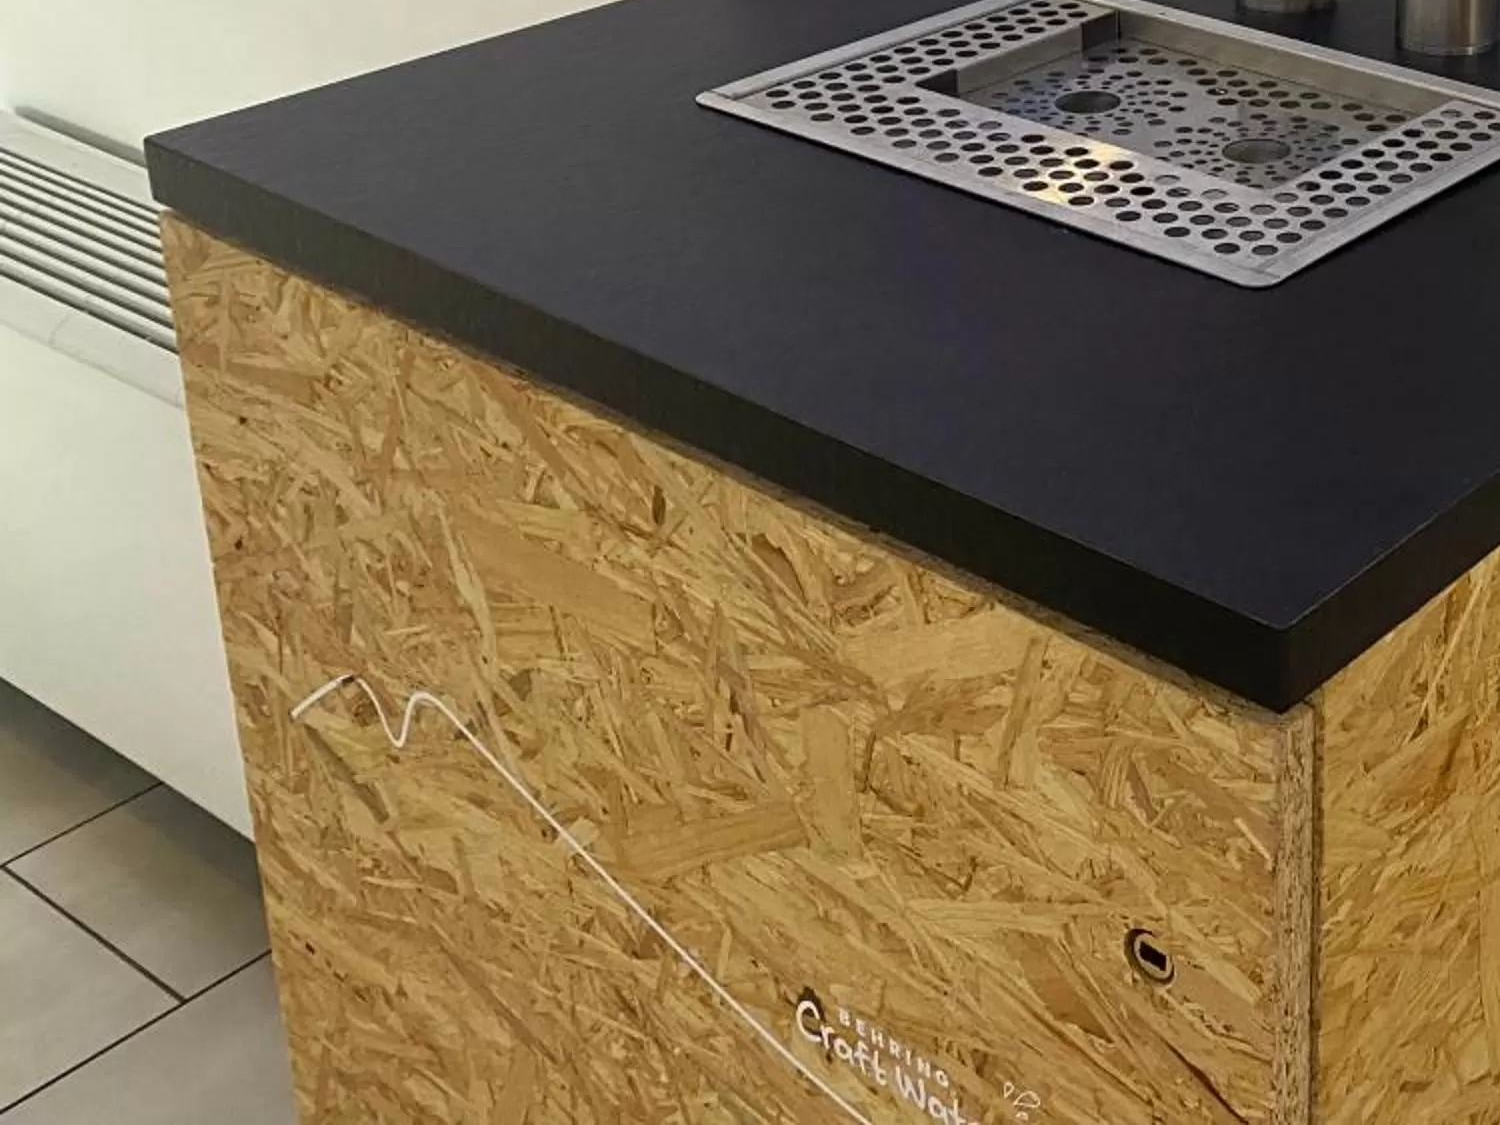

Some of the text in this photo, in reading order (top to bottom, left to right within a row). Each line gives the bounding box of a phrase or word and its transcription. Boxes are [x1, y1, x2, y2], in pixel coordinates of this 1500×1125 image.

[796, 999, 981, 1125] Craft Wat
[838, 1007, 950, 1088] BEHRING
